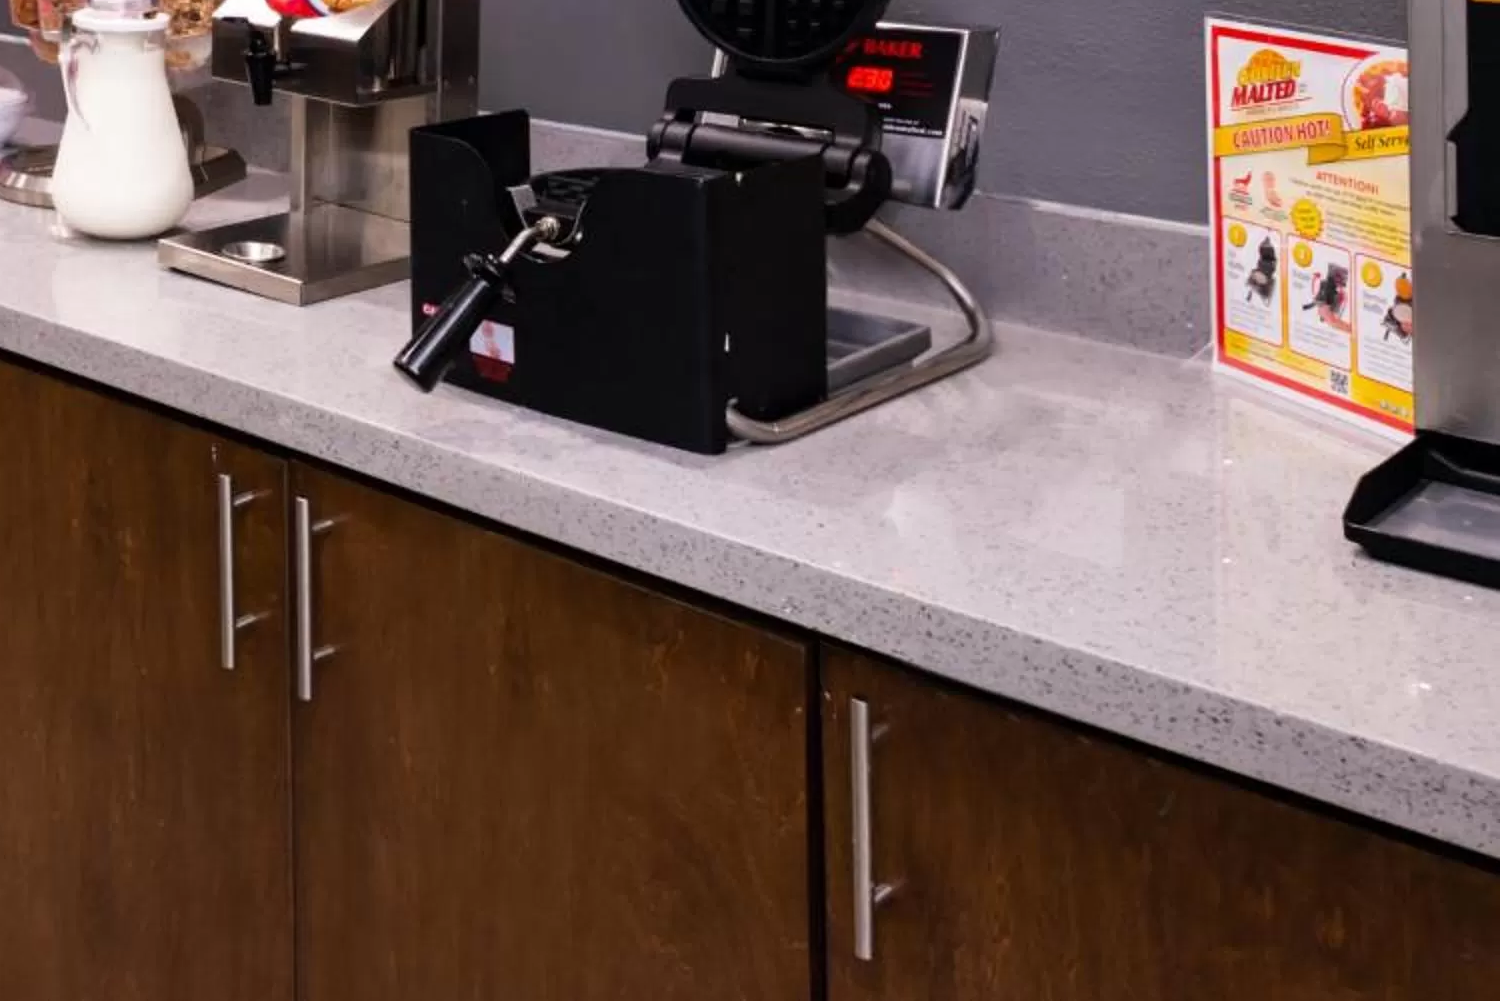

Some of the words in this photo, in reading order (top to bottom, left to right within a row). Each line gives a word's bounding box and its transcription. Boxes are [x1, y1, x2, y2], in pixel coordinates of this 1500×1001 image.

[864, 39, 922, 59] BAKER
[1231, 79, 1296, 107] MALTED
[1233, 125, 1293, 149] CAUTION
[1298, 119, 1331, 141] HOT!
[1355, 133, 1376, 151] Self
[1315, 170, 1379, 196] ATTENTION!
